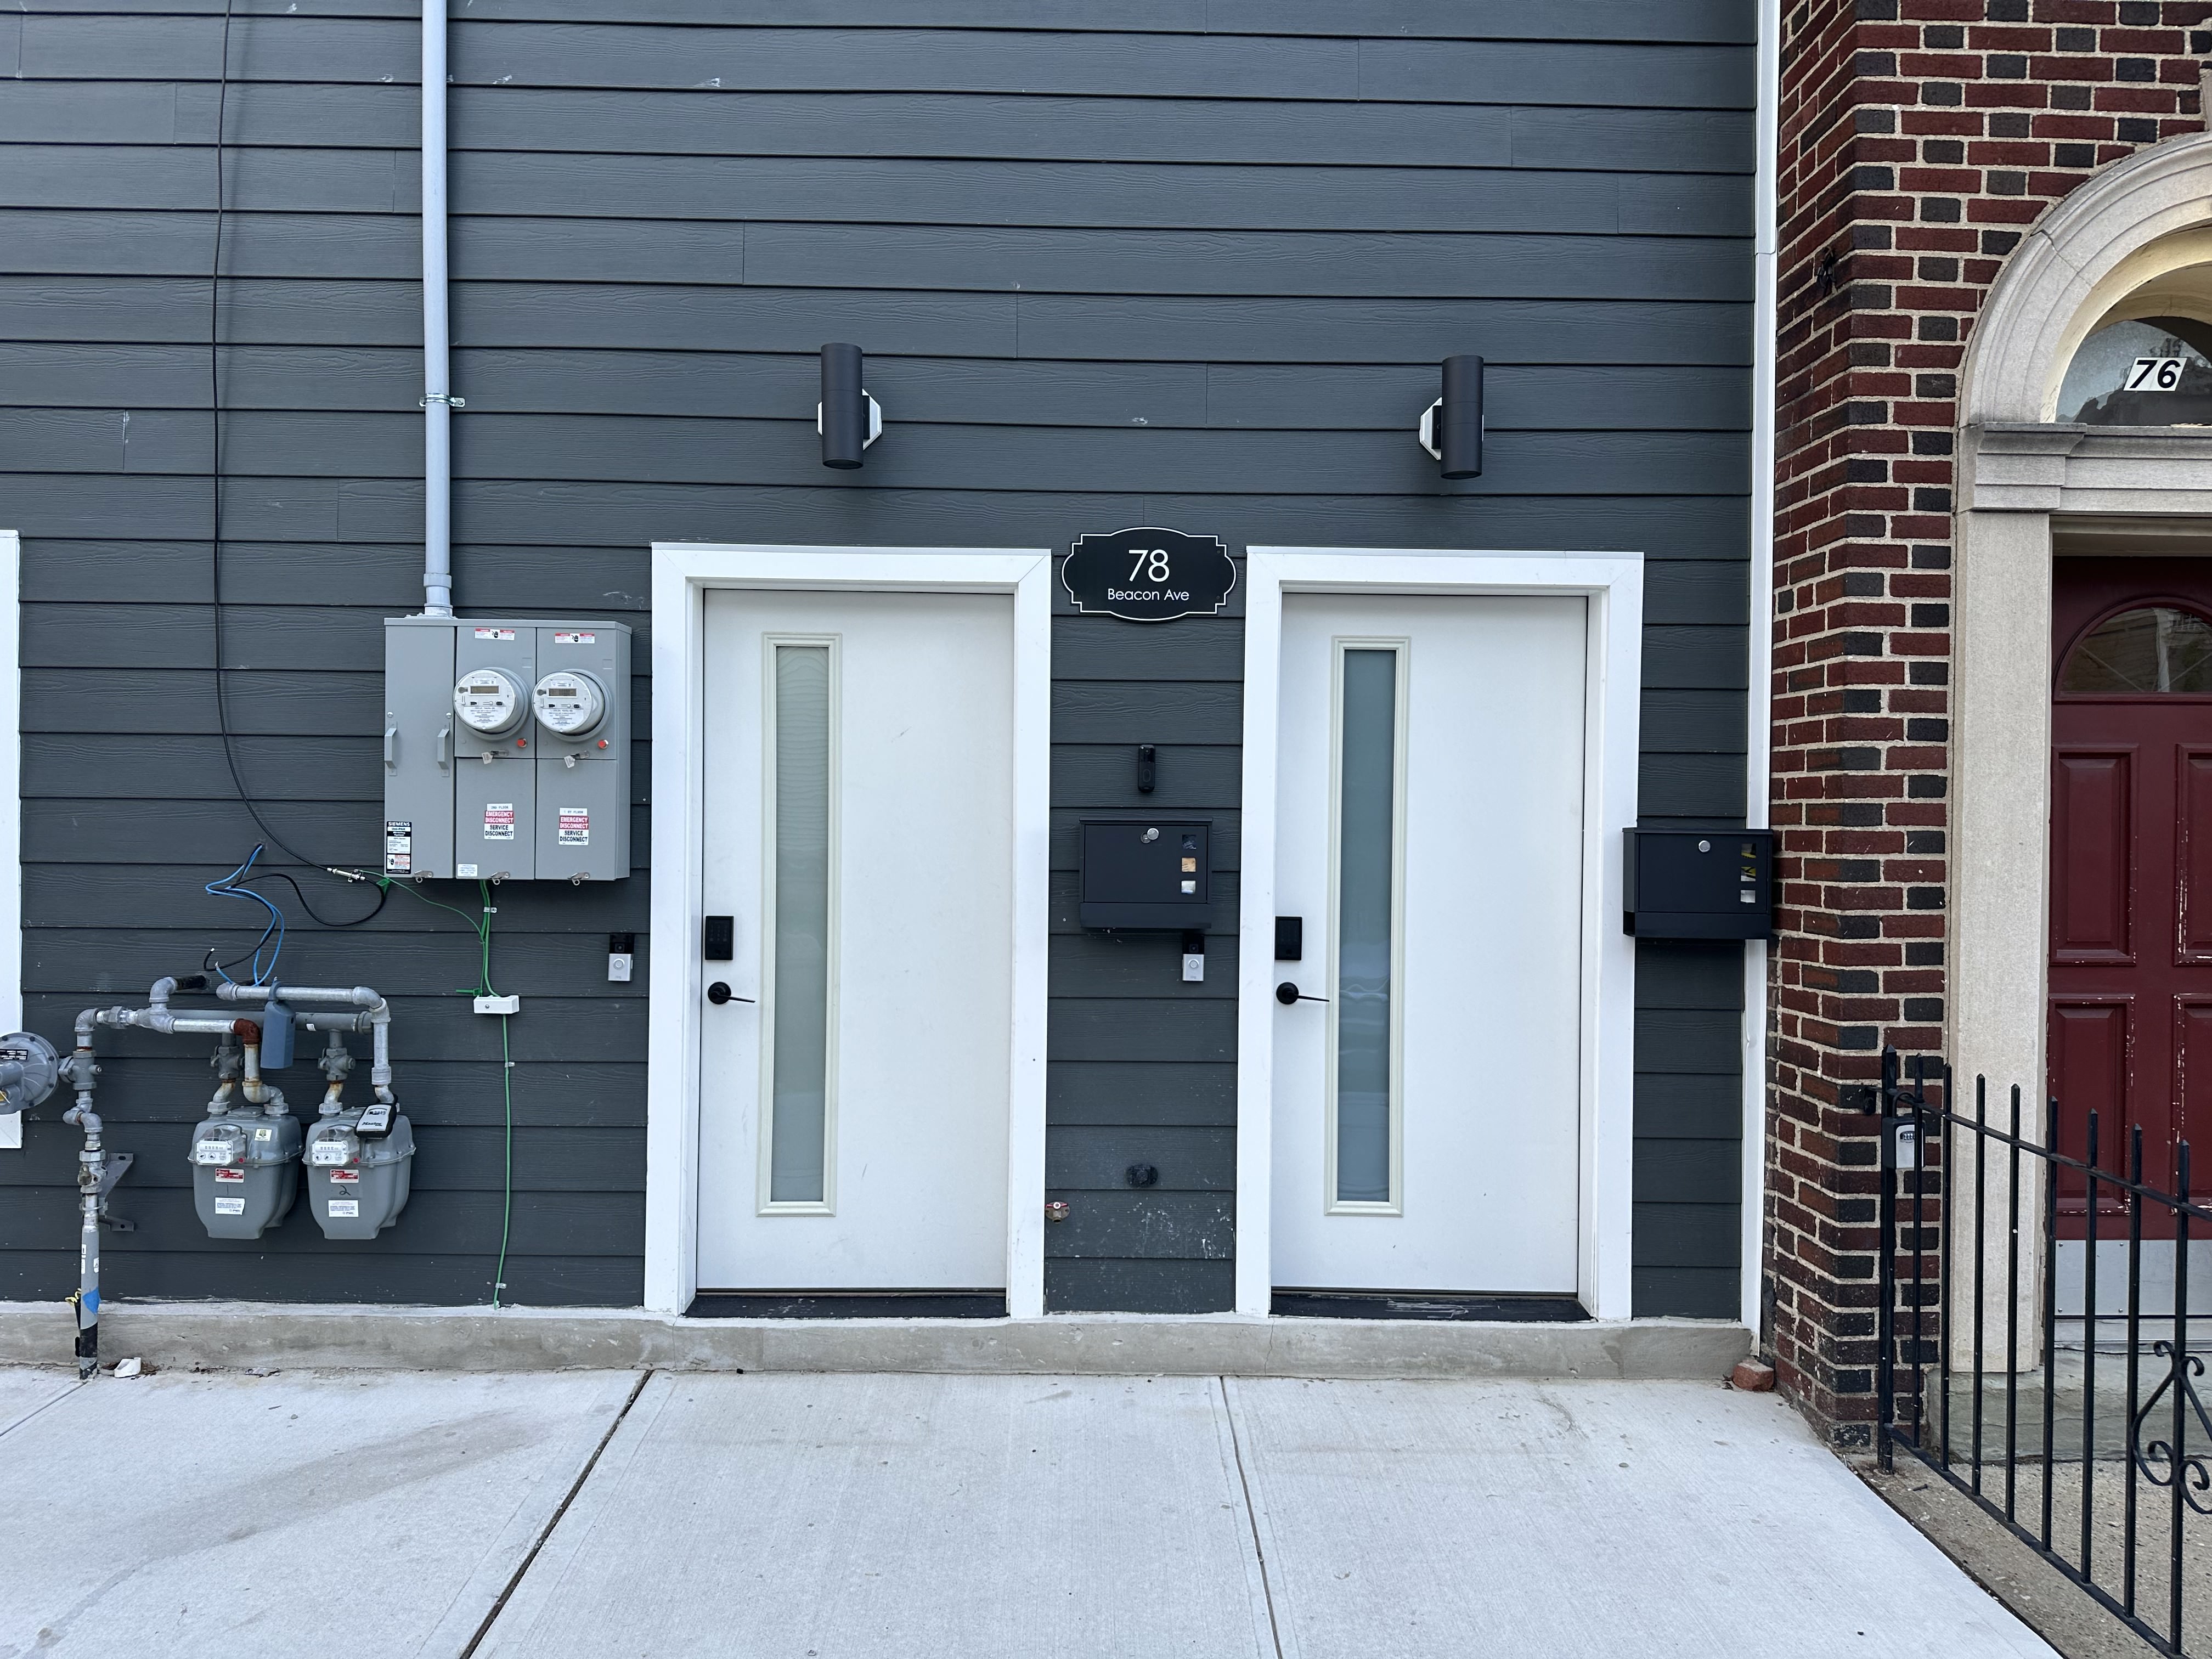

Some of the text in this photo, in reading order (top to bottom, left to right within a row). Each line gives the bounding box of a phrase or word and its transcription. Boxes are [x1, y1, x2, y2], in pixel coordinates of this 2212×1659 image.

[2129, 359, 2181, 389] 76
[1128, 549, 1170, 583] 78
[1108, 588, 1189, 601] Beacon Ave
[339, 1184, 352, 1196] 2
